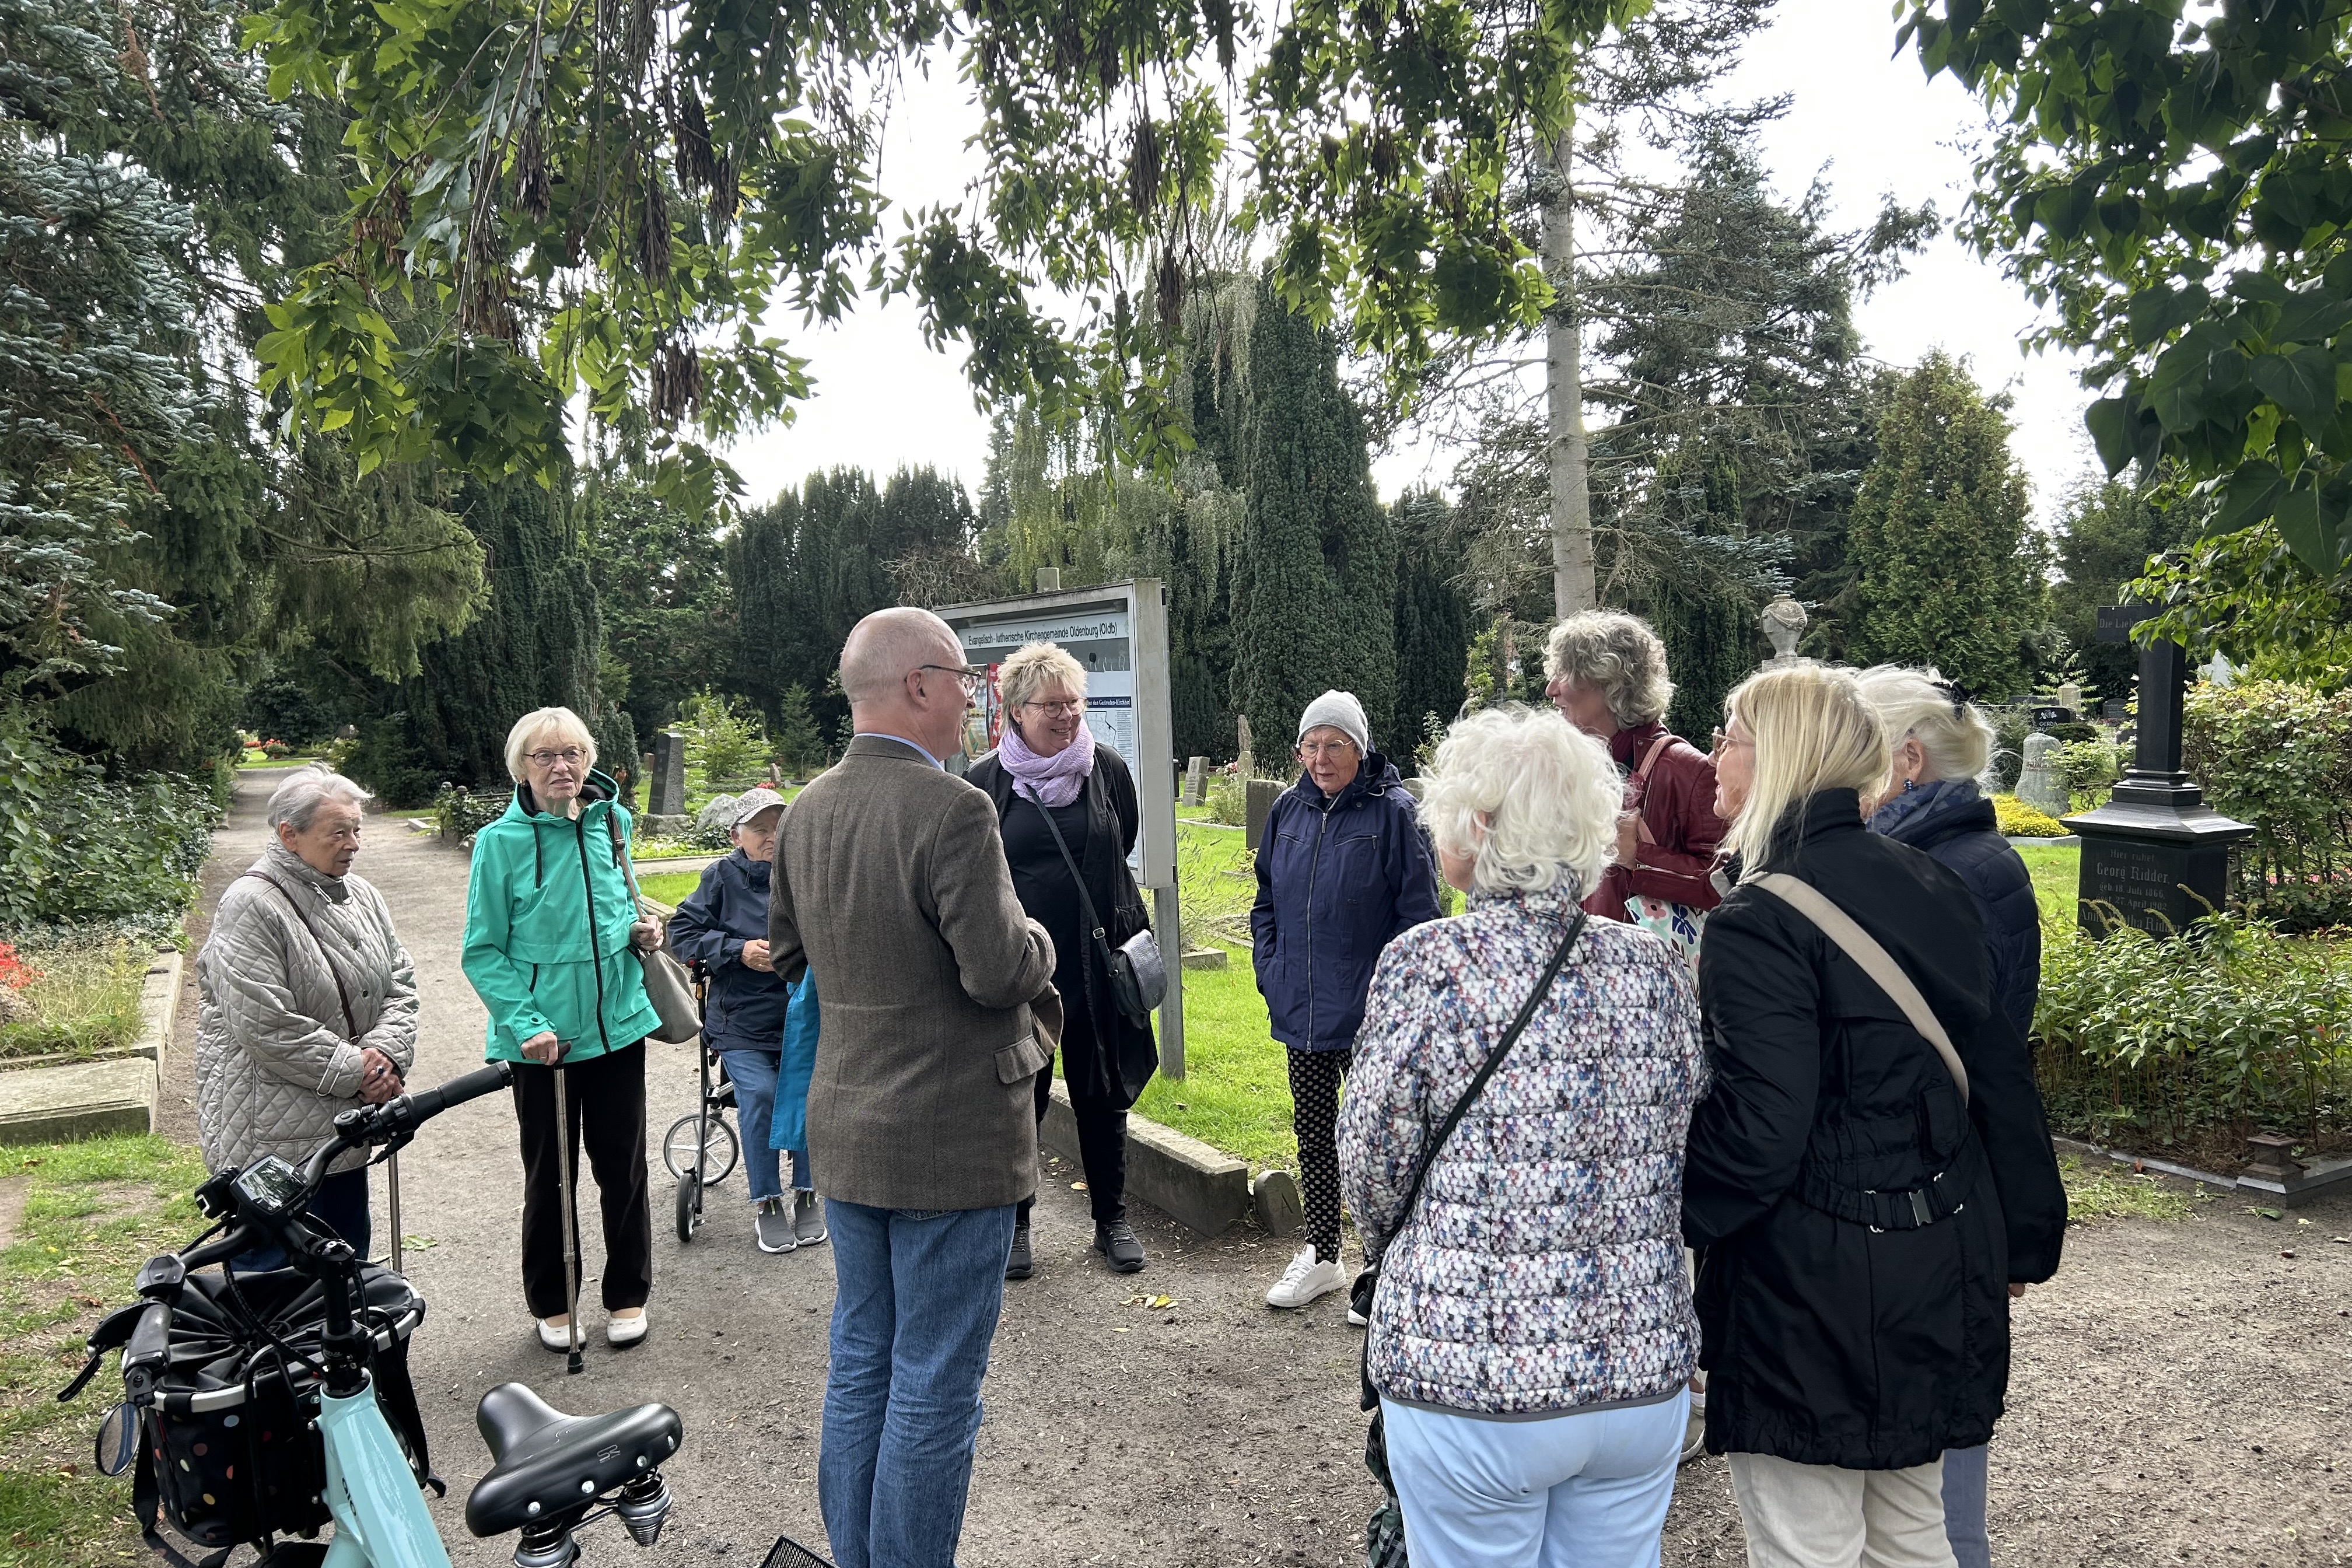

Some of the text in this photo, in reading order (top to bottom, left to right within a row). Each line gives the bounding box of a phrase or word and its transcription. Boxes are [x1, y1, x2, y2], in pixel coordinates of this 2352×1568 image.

[2099, 618, 2113, 628] Die
[1025, 626, 1069, 642] Kirchengemeinde
[1070, 625, 1098, 638] Oldenburg
[1100, 622, 1117, 637] (Oldb)
[2110, 849, 2155, 862] Hier ruhet
[2096, 862, 2126, 882] Georg
[2127, 898, 2147, 910] April
[1280, 1192, 1293, 1217] A
